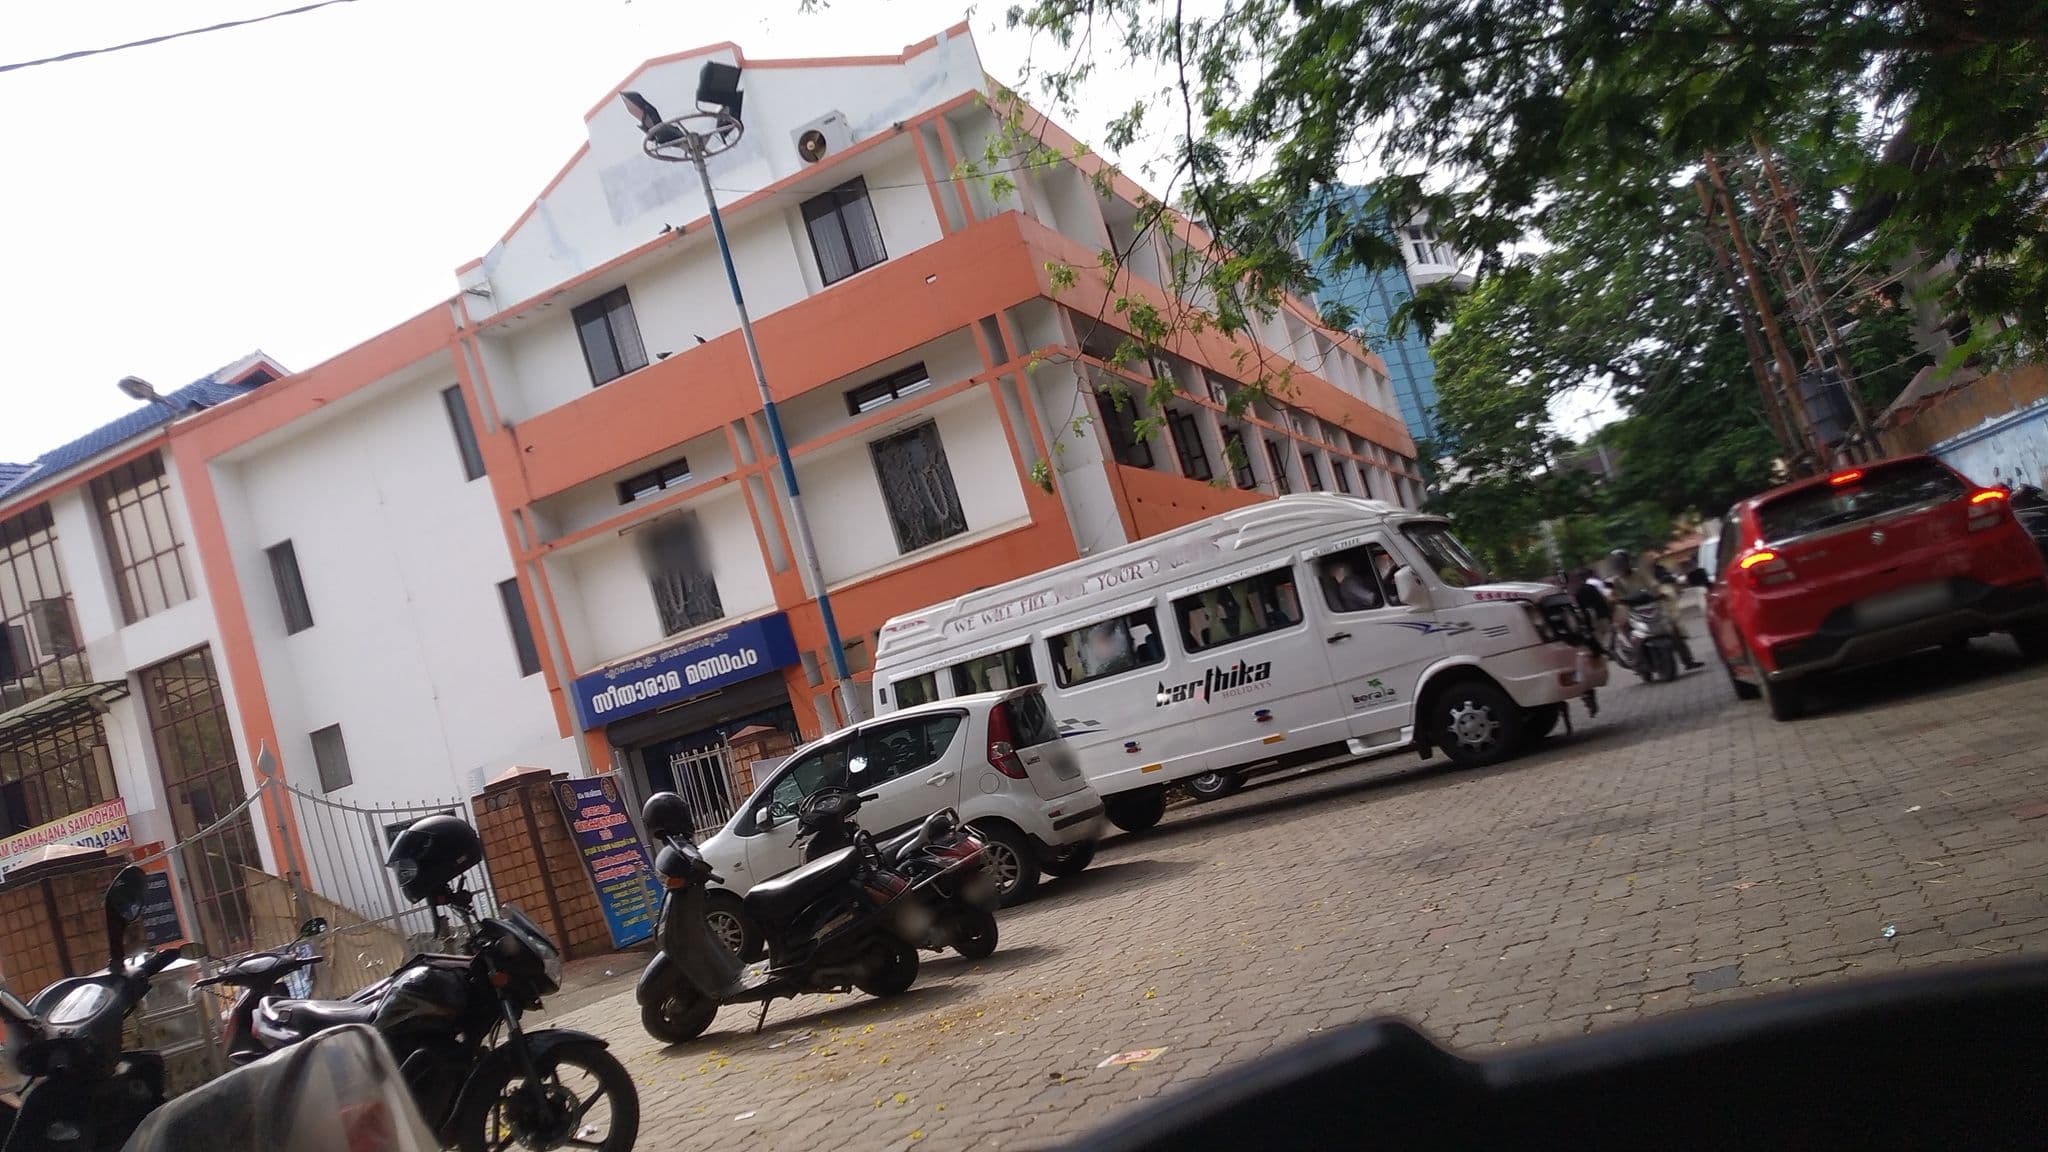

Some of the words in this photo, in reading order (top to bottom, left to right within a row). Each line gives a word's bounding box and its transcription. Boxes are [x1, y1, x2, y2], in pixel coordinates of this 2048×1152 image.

[954, 617, 976, 634] WE
[982, 604, 1013, 627] WILL
[1097, 563, 1144, 592] YOUR
[592, 672, 681, 713] സീതാരാമ
[1222, 681, 1272, 699] HOLIDAYS
[11, 824, 66, 854] GRAMAJANA
[68, 802, 123, 834] SAMOOHAM
